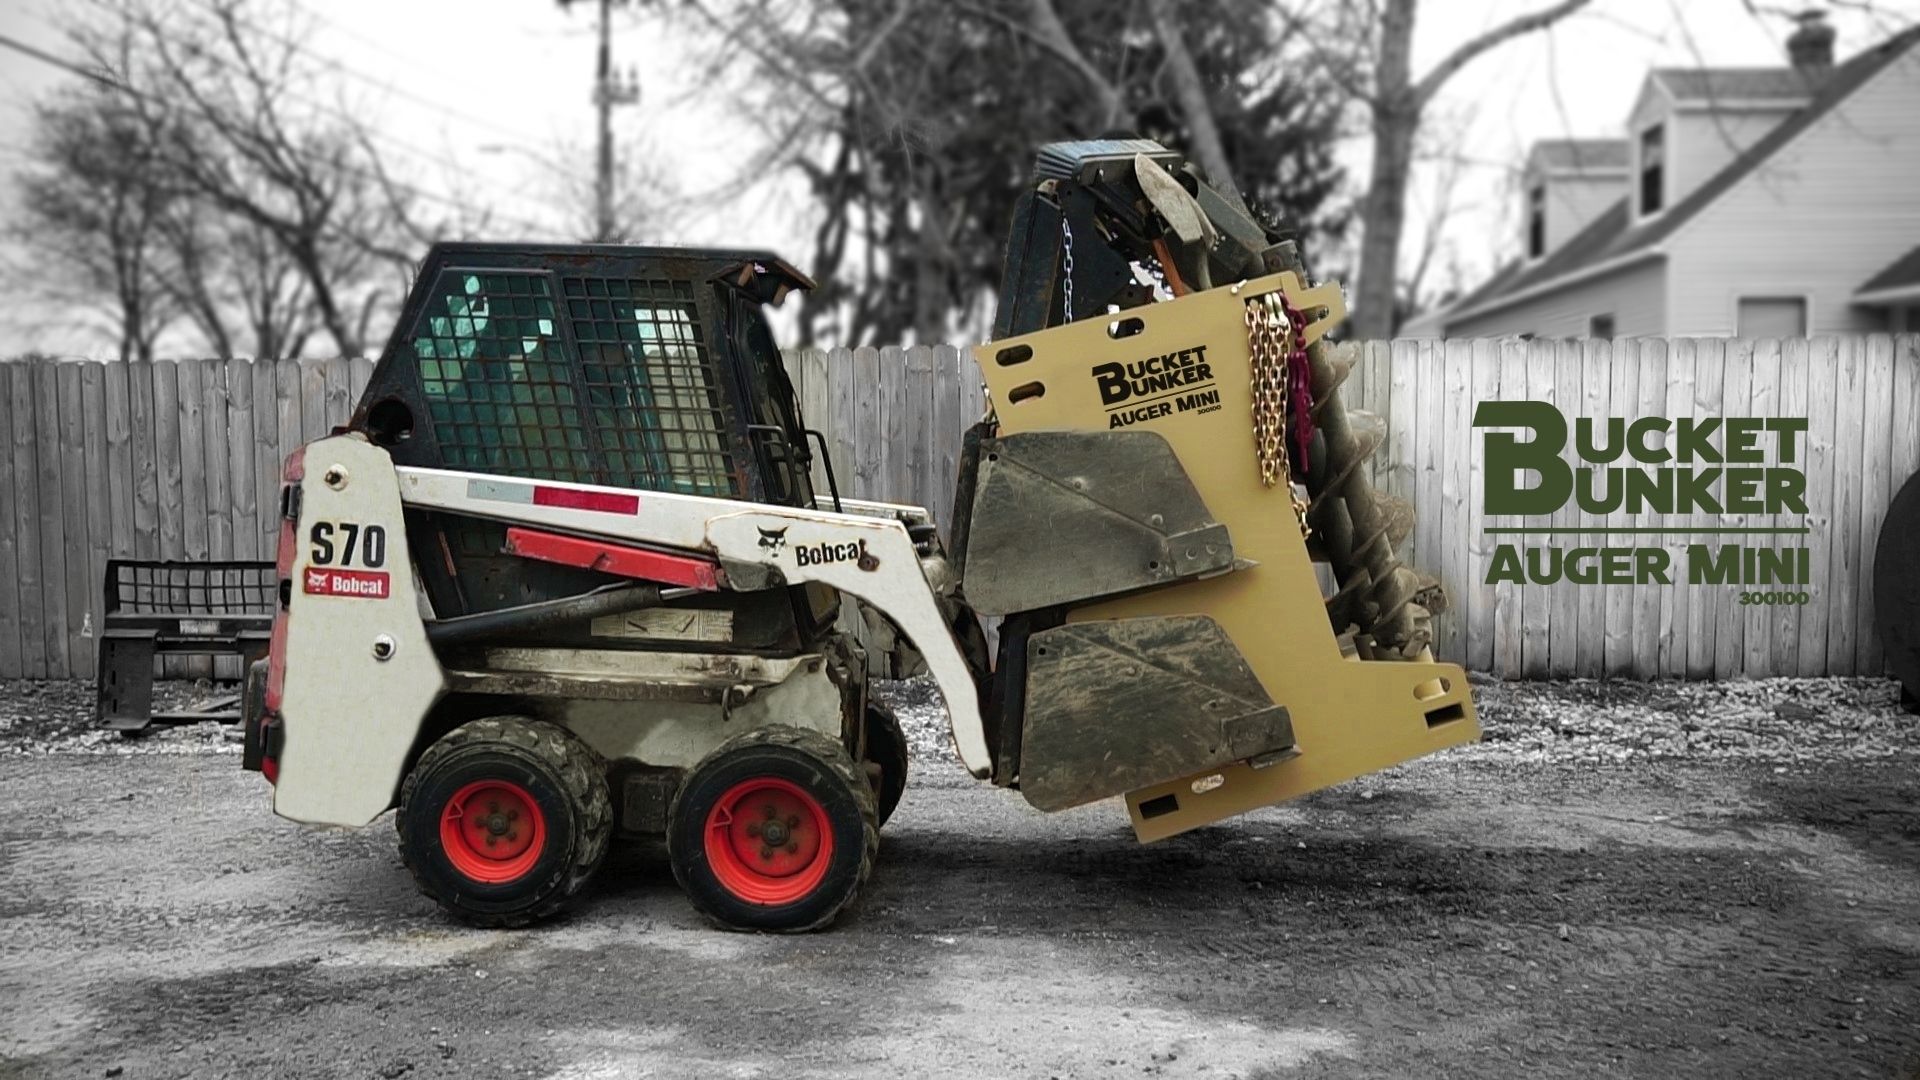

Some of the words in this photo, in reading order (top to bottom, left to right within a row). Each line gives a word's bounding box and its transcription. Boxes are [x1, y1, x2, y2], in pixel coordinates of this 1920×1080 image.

[1092, 345, 1207, 406] BUCKET
[1109, 402, 1173, 429] AUGER
[1176, 390, 1221, 413] MINI
[310, 521, 386, 568] S70
[795, 539, 867, 567] Bobca
[332, 575, 383, 595] Bobcat
